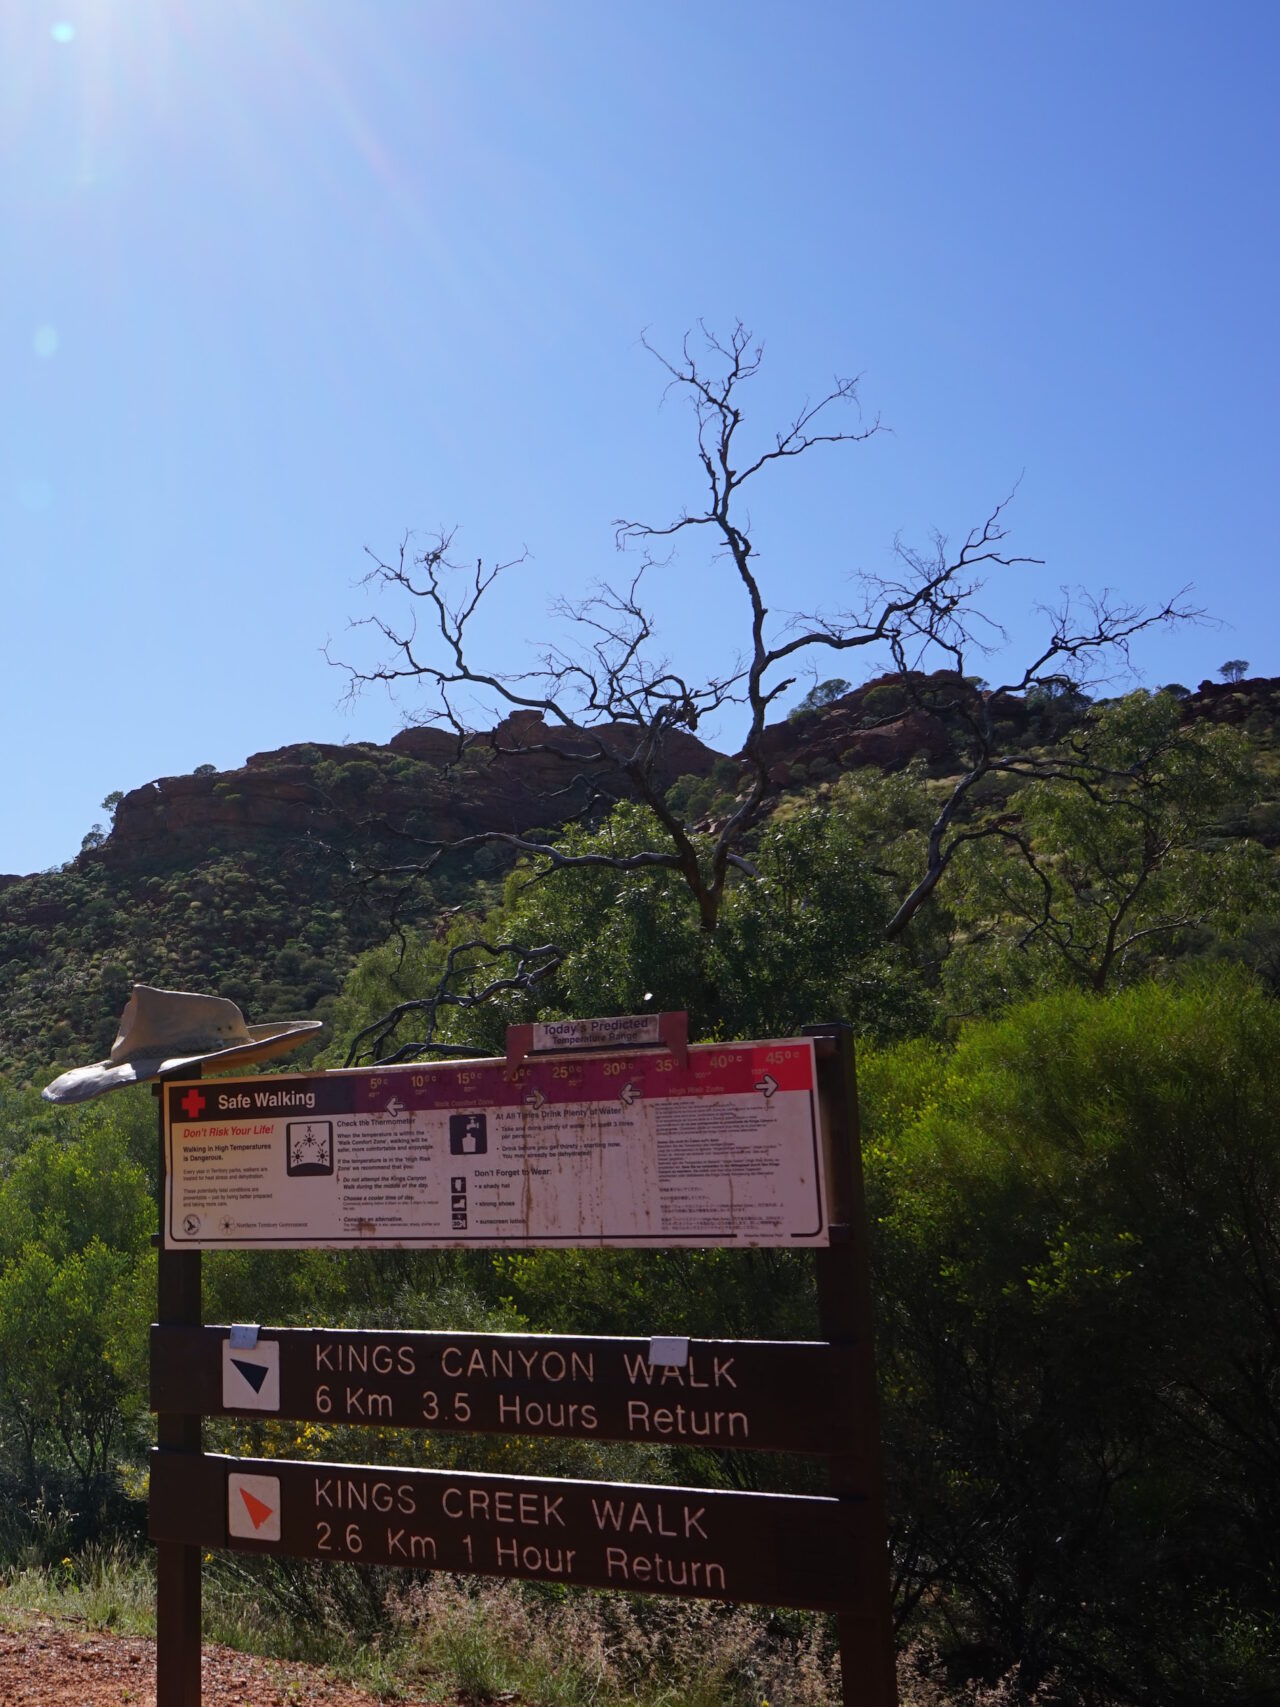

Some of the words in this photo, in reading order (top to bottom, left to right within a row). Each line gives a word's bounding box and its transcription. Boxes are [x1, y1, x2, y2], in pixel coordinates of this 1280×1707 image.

[544, 1022, 586, 1035] Today's
[591, 1018, 648, 1031] Predicted
[553, 1034, 606, 1045] Temperature
[609, 1031, 637, 1041] Range
[218, 1094, 250, 1110] Safe
[254, 1091, 316, 1108] Walking
[517, 1110, 540, 1120] Times
[541, 1110, 562, 1118] Drink
[563, 1108, 588, 1119] Plenty
[597, 1106, 622, 1116] Water
[183, 1128, 207, 1138] Don't
[209, 1126, 229, 1137] Risk
[231, 1126, 251, 1135] Your
[253, 1124, 274, 1135] Life!
[215, 1145, 229, 1153] High
[230, 1144, 271, 1152] Temperatures
[496, 1169, 520, 1178] Forget
[530, 1167, 552, 1175] Wear:
[316, 1344, 416, 1375] KINGS
[441, 1347, 594, 1383] CANYON
[624, 1354, 737, 1388] WALK
[316, 1385, 332, 1413] 6
[346, 1387, 393, 1417] Km
[423, 1391, 471, 1422] 3.5
[499, 1394, 598, 1429] Hours
[628, 1400, 749, 1438] Return
[315, 1478, 416, 1514] KINGS
[442, 1488, 565, 1526] CREEK
[592, 1499, 708, 1539] WALK
[316, 1522, 363, 1553] 2.6
[387, 1528, 436, 1560] Km
[463, 1534, 473, 1563] 1
[496, 1536, 576, 1572] Hour
[606, 1547, 726, 1590] Return
